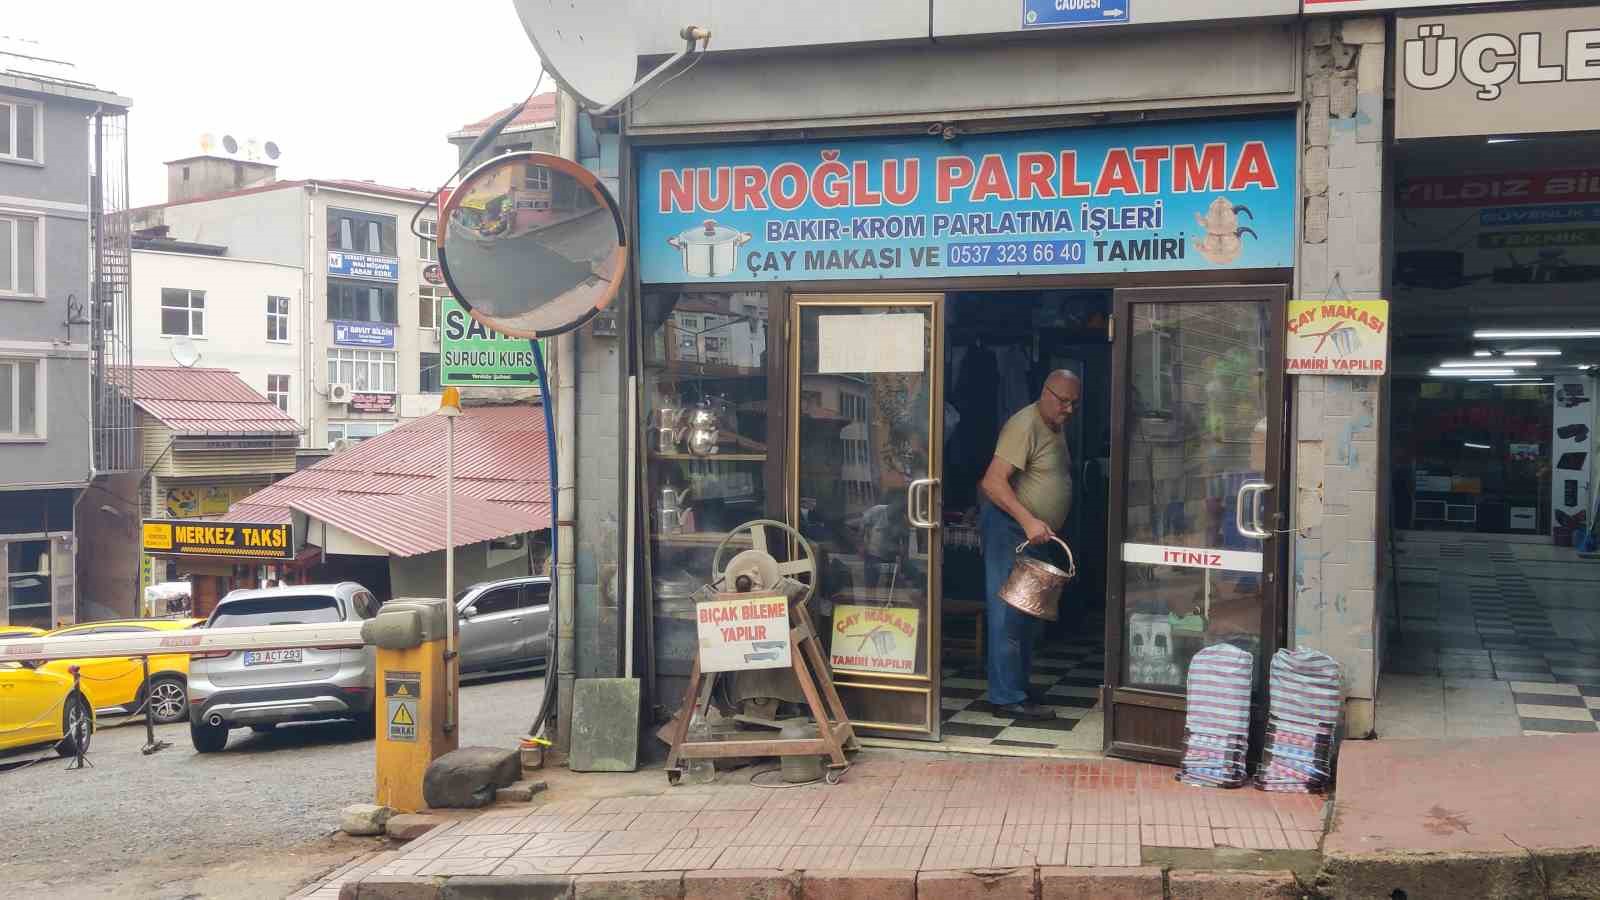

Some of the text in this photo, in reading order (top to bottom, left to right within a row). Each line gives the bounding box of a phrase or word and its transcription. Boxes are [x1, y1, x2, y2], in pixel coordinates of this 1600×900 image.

[659, 140, 1279, 213] NUROĞLU PARLATMA
[766, 200, 1163, 242] BAKIR-KROM PARLATMA İŞLERİ
[746, 232, 1185, 277] ÇAY MAKASI VE 0537 323 66 40 TAMİRİ
[1287, 304, 1385, 334] ÇAY MAKASI
[500, 351, 537, 367] KURS
[1286, 356, 1384, 370] TAMİRİ YAPILIR
[175, 526, 235, 546] MERKEZ
[241, 524, 288, 548] TAKSİ
[1163, 547, 1222, 566] İTİNİZ
[699, 600, 785, 625] BIÇAK BİLEME
[836, 607, 914, 637] ÇAY MAKASI
[720, 625, 767, 642] YAPILIR
